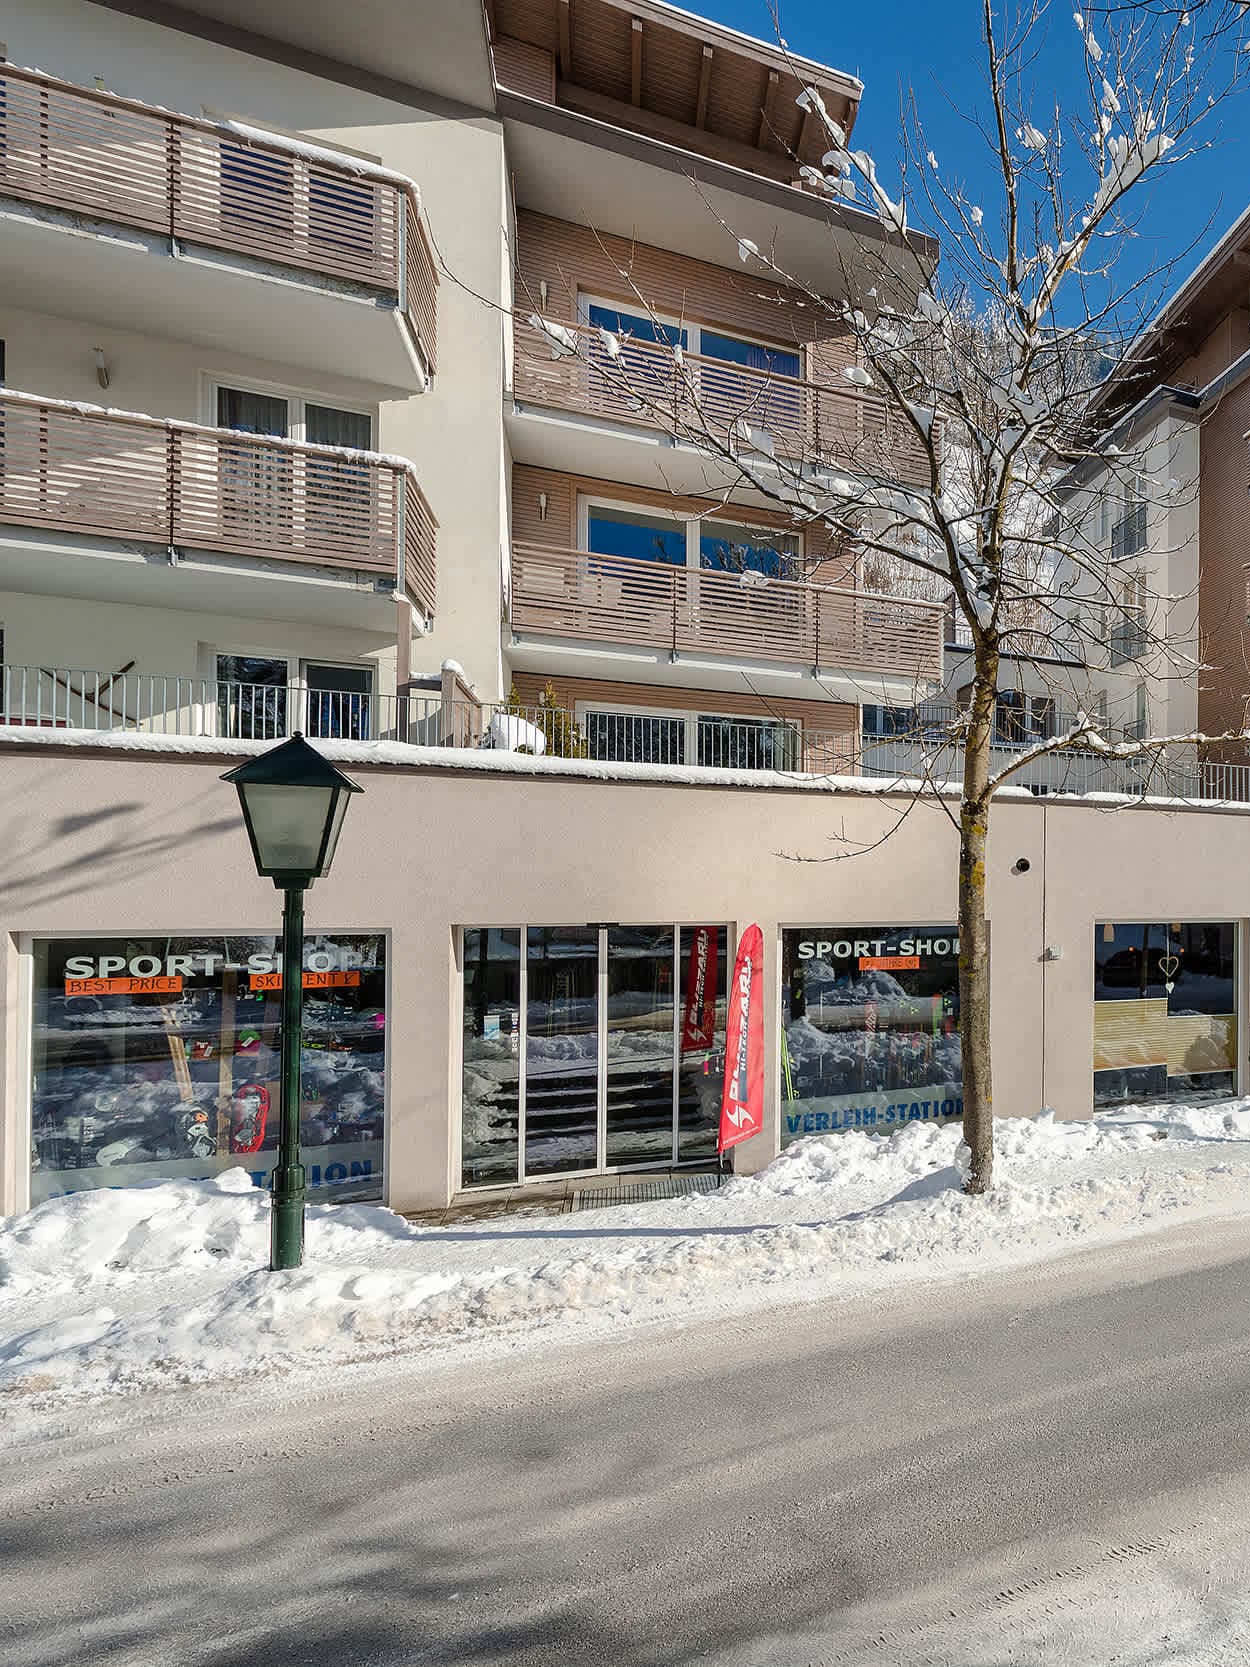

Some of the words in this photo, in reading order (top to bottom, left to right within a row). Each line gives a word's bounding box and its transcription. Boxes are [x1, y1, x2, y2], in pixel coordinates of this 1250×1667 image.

[65, 952, 362, 980] SPORT-SOP
[69, 979, 115, 993] BEST
[127, 977, 178, 991] PRICE
[255, 974, 281, 989] SKI
[305, 973, 338, 985] ENT
